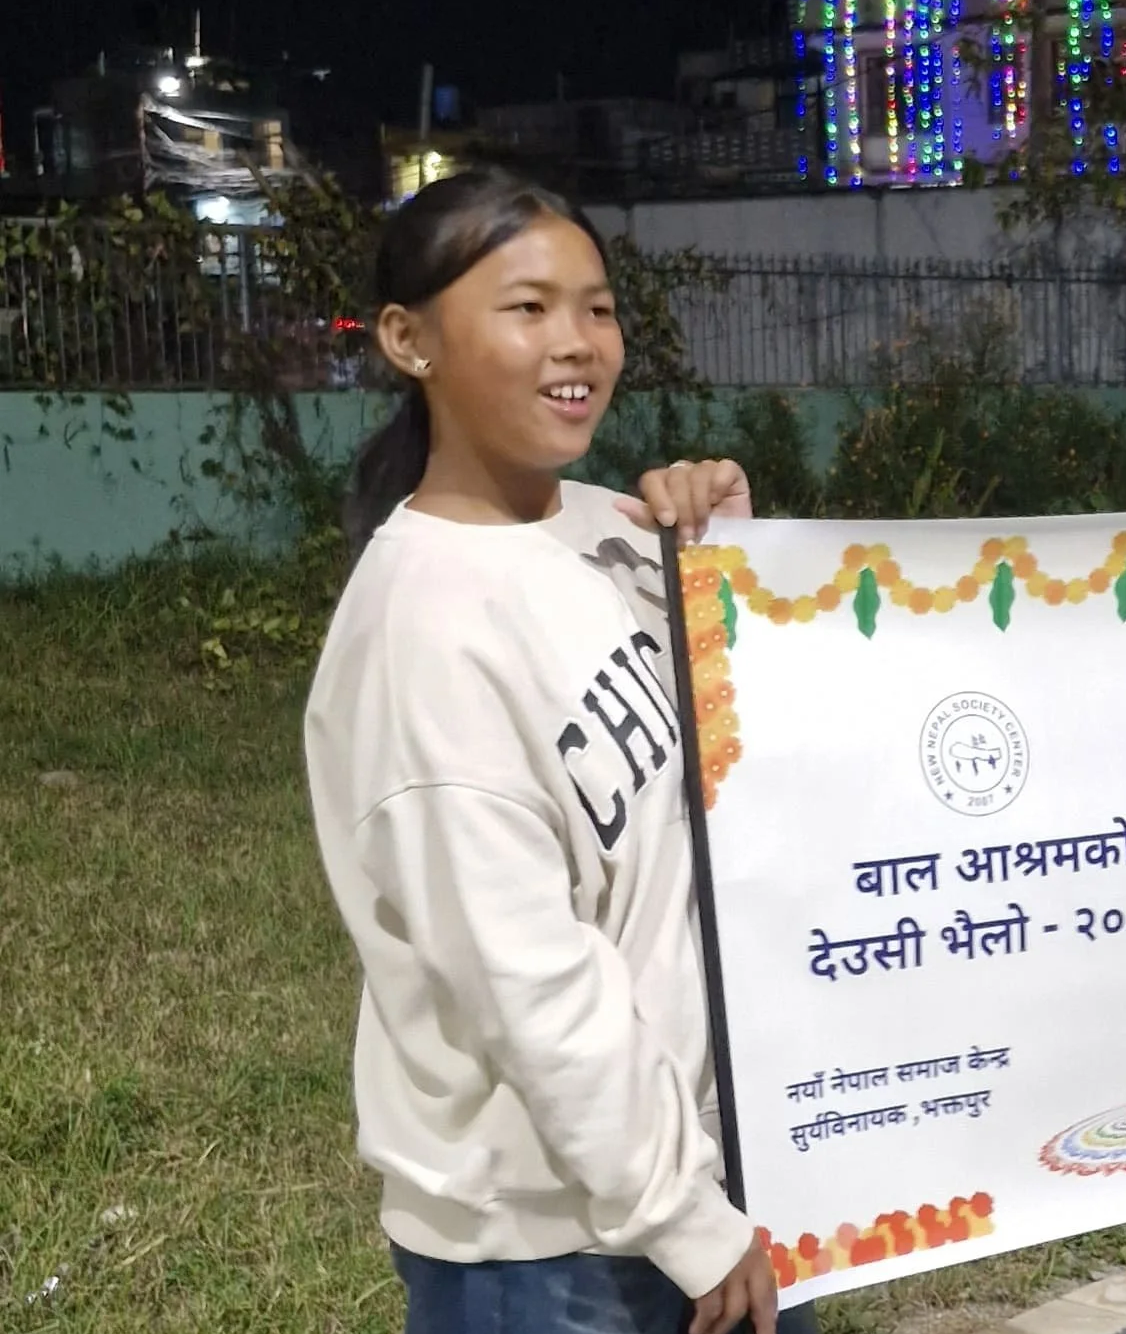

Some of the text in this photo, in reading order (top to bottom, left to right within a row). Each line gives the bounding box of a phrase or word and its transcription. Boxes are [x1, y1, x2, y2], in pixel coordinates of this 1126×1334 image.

[927, 699, 1024, 786] NEW NEPAL SOCIETY CENTER
[852, 852, 941, 898] बाल
[807, 916, 926, 982] देउसी
[940, 902, 1030, 960] भैलो
[785, 1044, 1011, 1103] नयाँ नेपाल समाज केन्द्र
[789, 1103, 908, 1152] सुर्यविनायक
